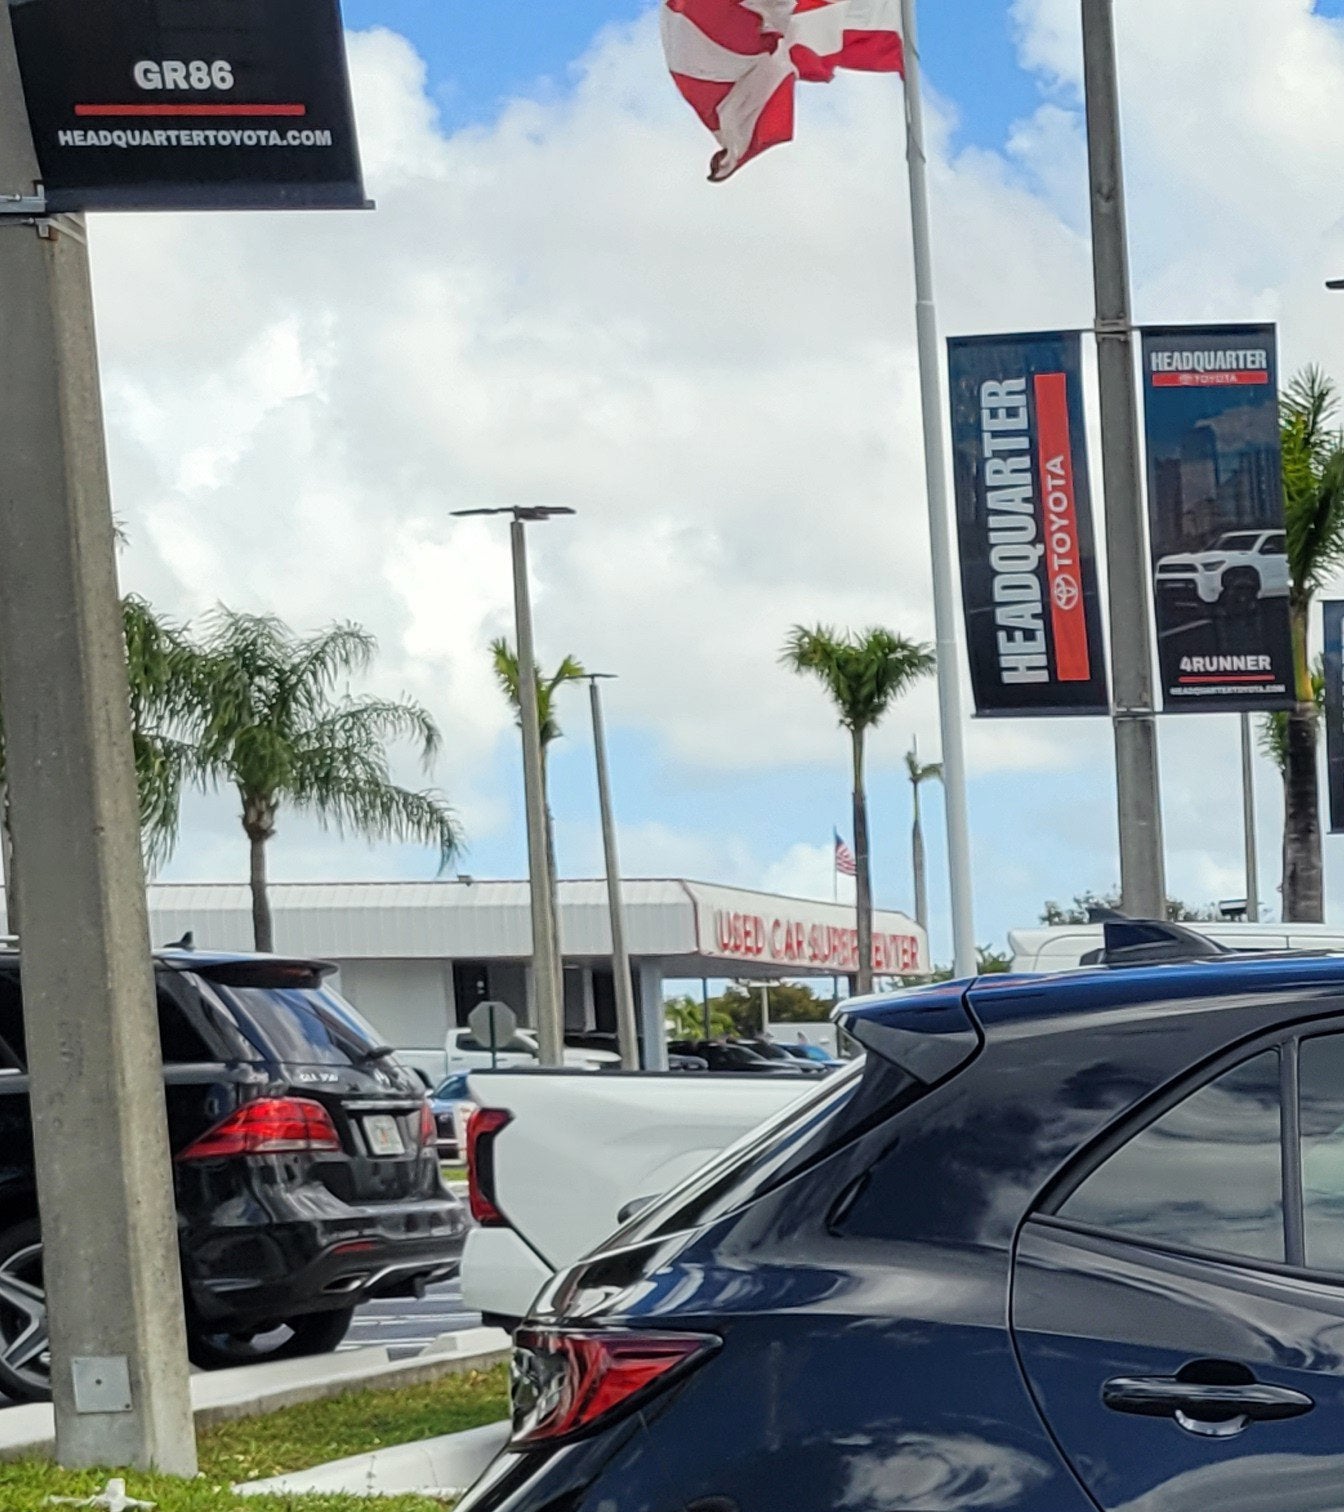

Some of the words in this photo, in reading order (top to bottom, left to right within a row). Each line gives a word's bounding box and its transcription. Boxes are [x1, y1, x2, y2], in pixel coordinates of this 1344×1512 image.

[133, 60, 235, 90] GR86
[58, 129, 333, 149] HEADQUARTERTOYOTA.COM
[1150, 349, 1268, 373] HEADQUARTER
[1044, 454, 1073, 570] TOYOTA
[980, 376, 1050, 684] HEADQUARTER
[1179, 654, 1272, 672] 4RUNNER
[718, 910, 765, 956] USED
[771, 918, 804, 959] CAR
